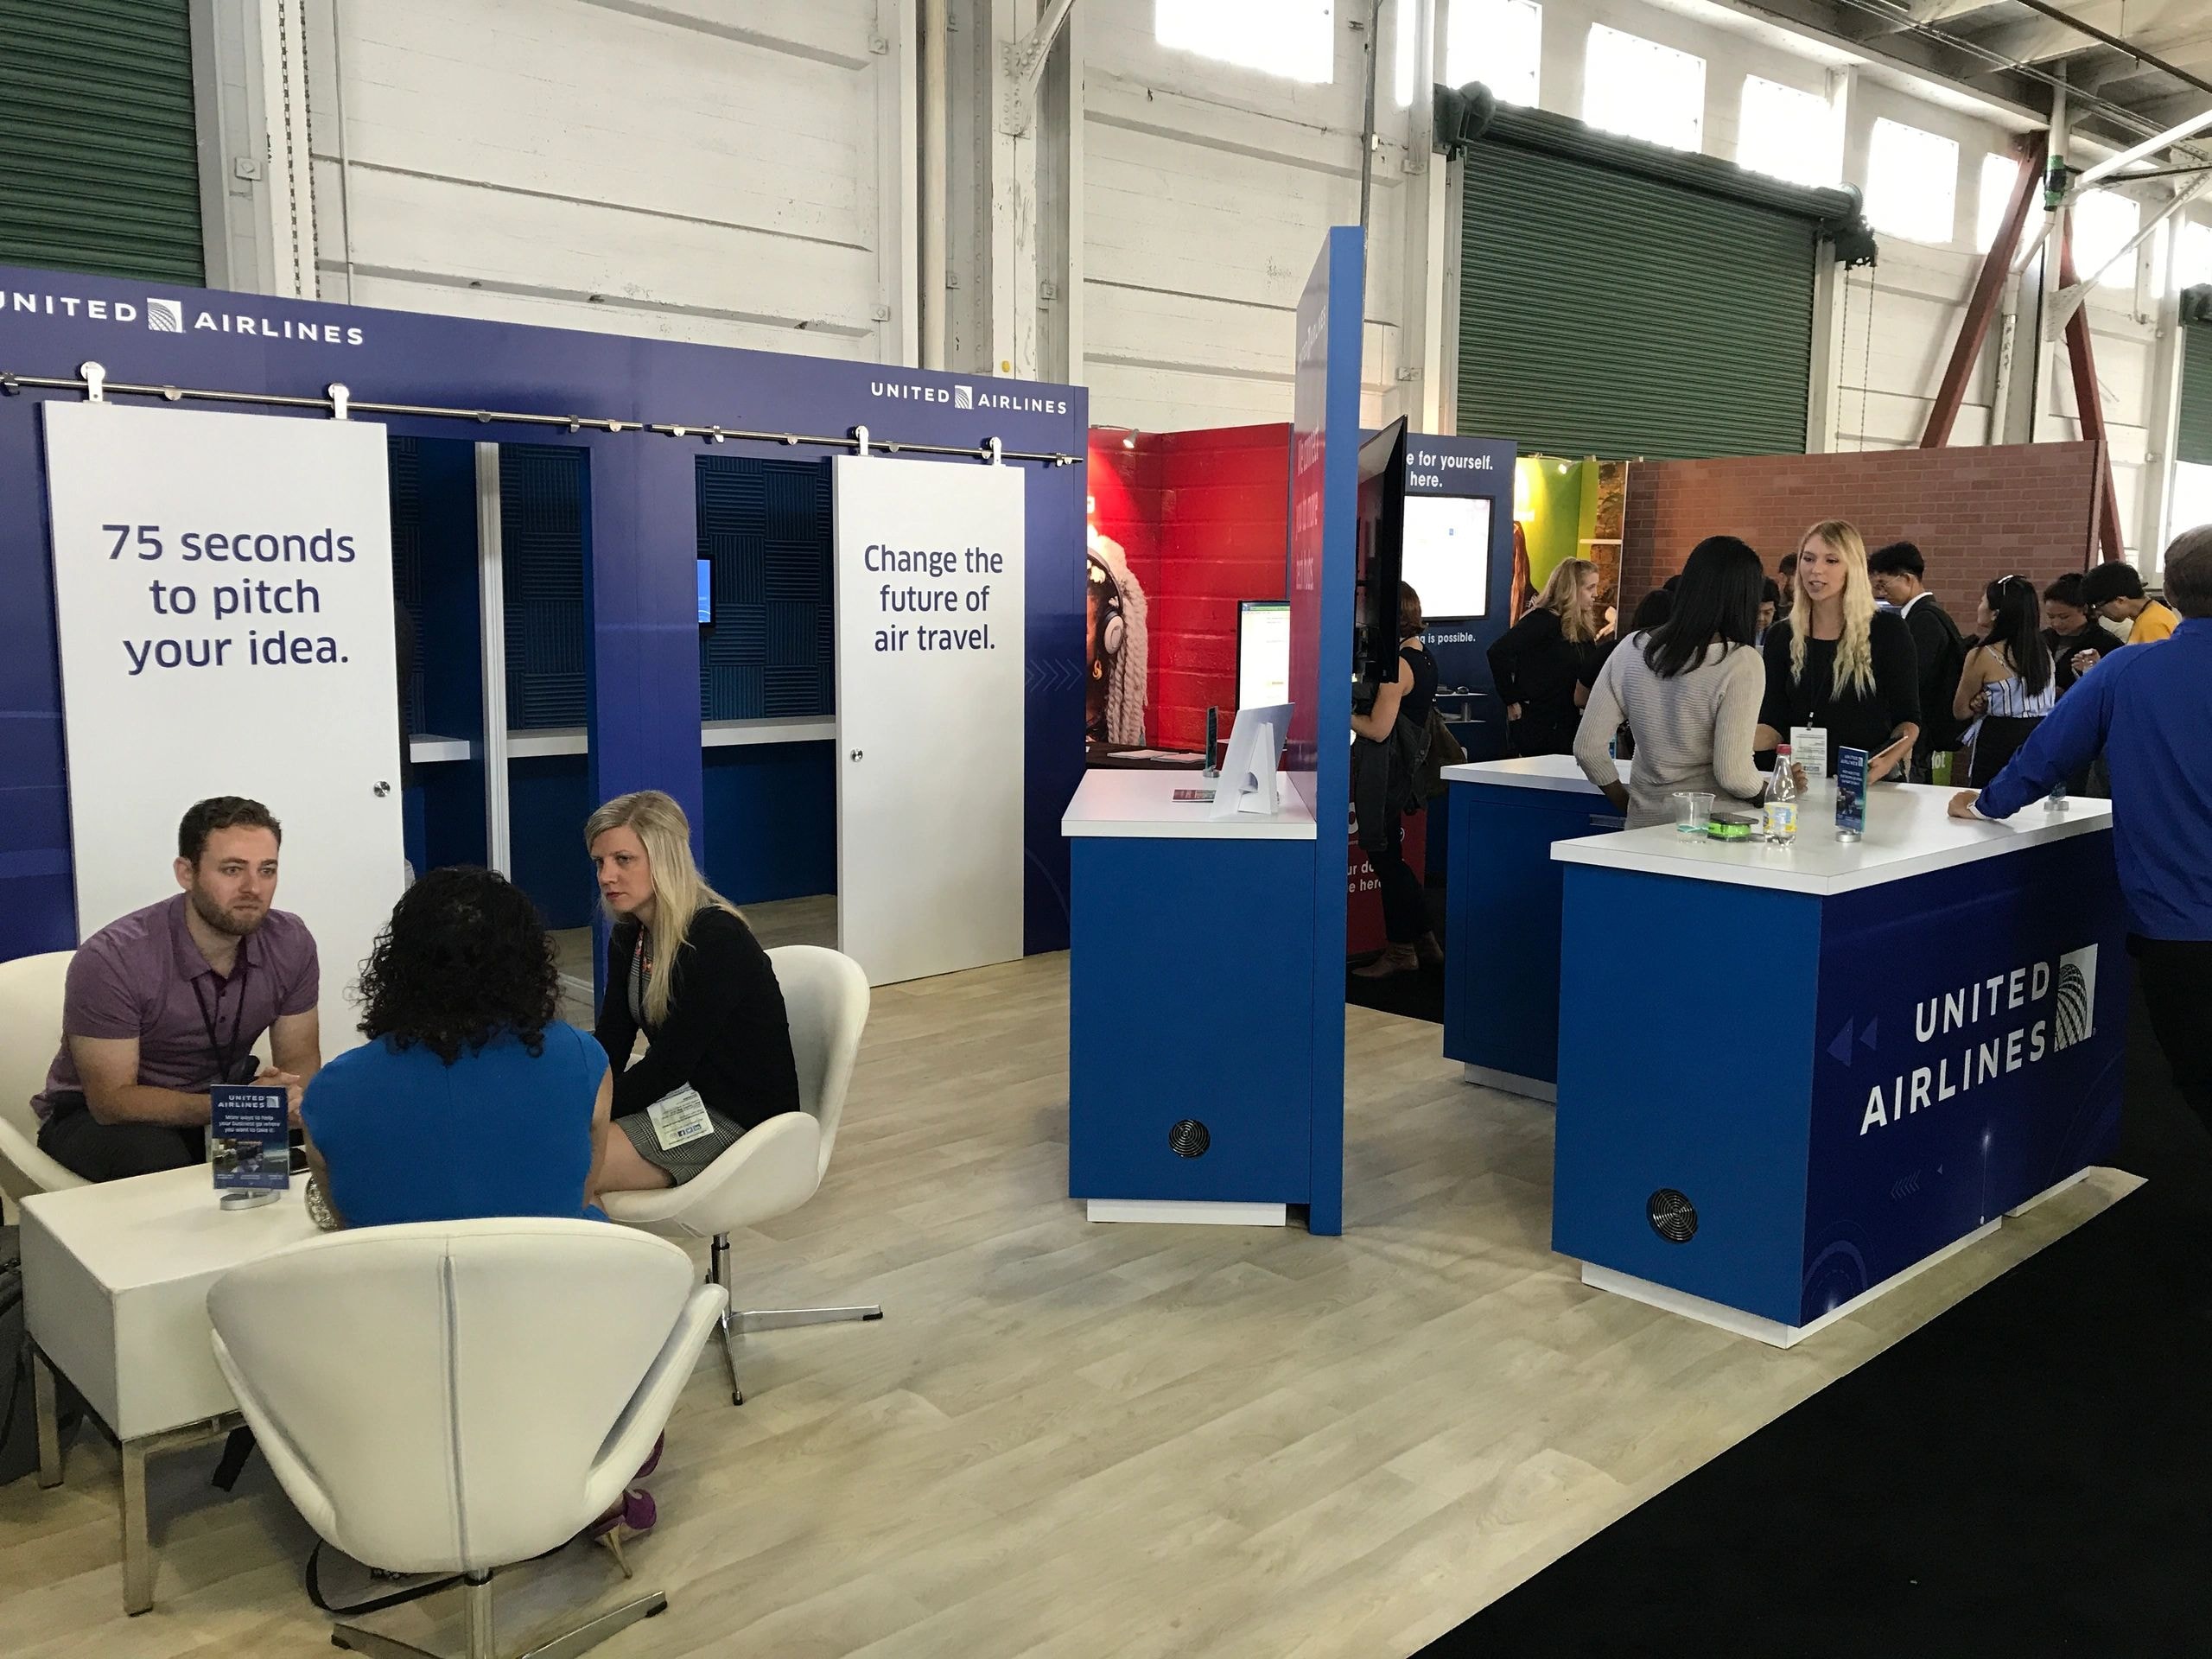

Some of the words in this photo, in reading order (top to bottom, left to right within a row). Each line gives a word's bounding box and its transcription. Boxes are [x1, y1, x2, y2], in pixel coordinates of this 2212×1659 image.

[0, 291, 137, 321] NITED
[194, 311, 364, 346] AIRLINES
[871, 382, 950, 403] UNITED
[978, 393, 1067, 415] AIRLINES
[1418, 450, 1437, 467] for
[1440, 454, 1493, 471] yourself.
[1409, 470, 1443, 487] here.
[102, 524, 163, 561] 75
[181, 528, 356, 563] seconds
[864, 543, 957, 578] Change
[964, 546, 1003, 574] the
[149, 580, 196, 615] to
[213, 577, 320, 620] pitch
[880, 584, 958, 613] future
[965, 585, 990, 612] of
[123, 639, 232, 676] your
[249, 629, 348, 665] idea.
[874, 624, 909, 652] air
[917, 623, 995, 652] travel.
[1427, 633, 1435, 644] is
[1438, 632, 1476, 645] possible.
[1916, 961, 2050, 1043] UNITED
[1859, 1020, 2046, 1136] AIRLINES
